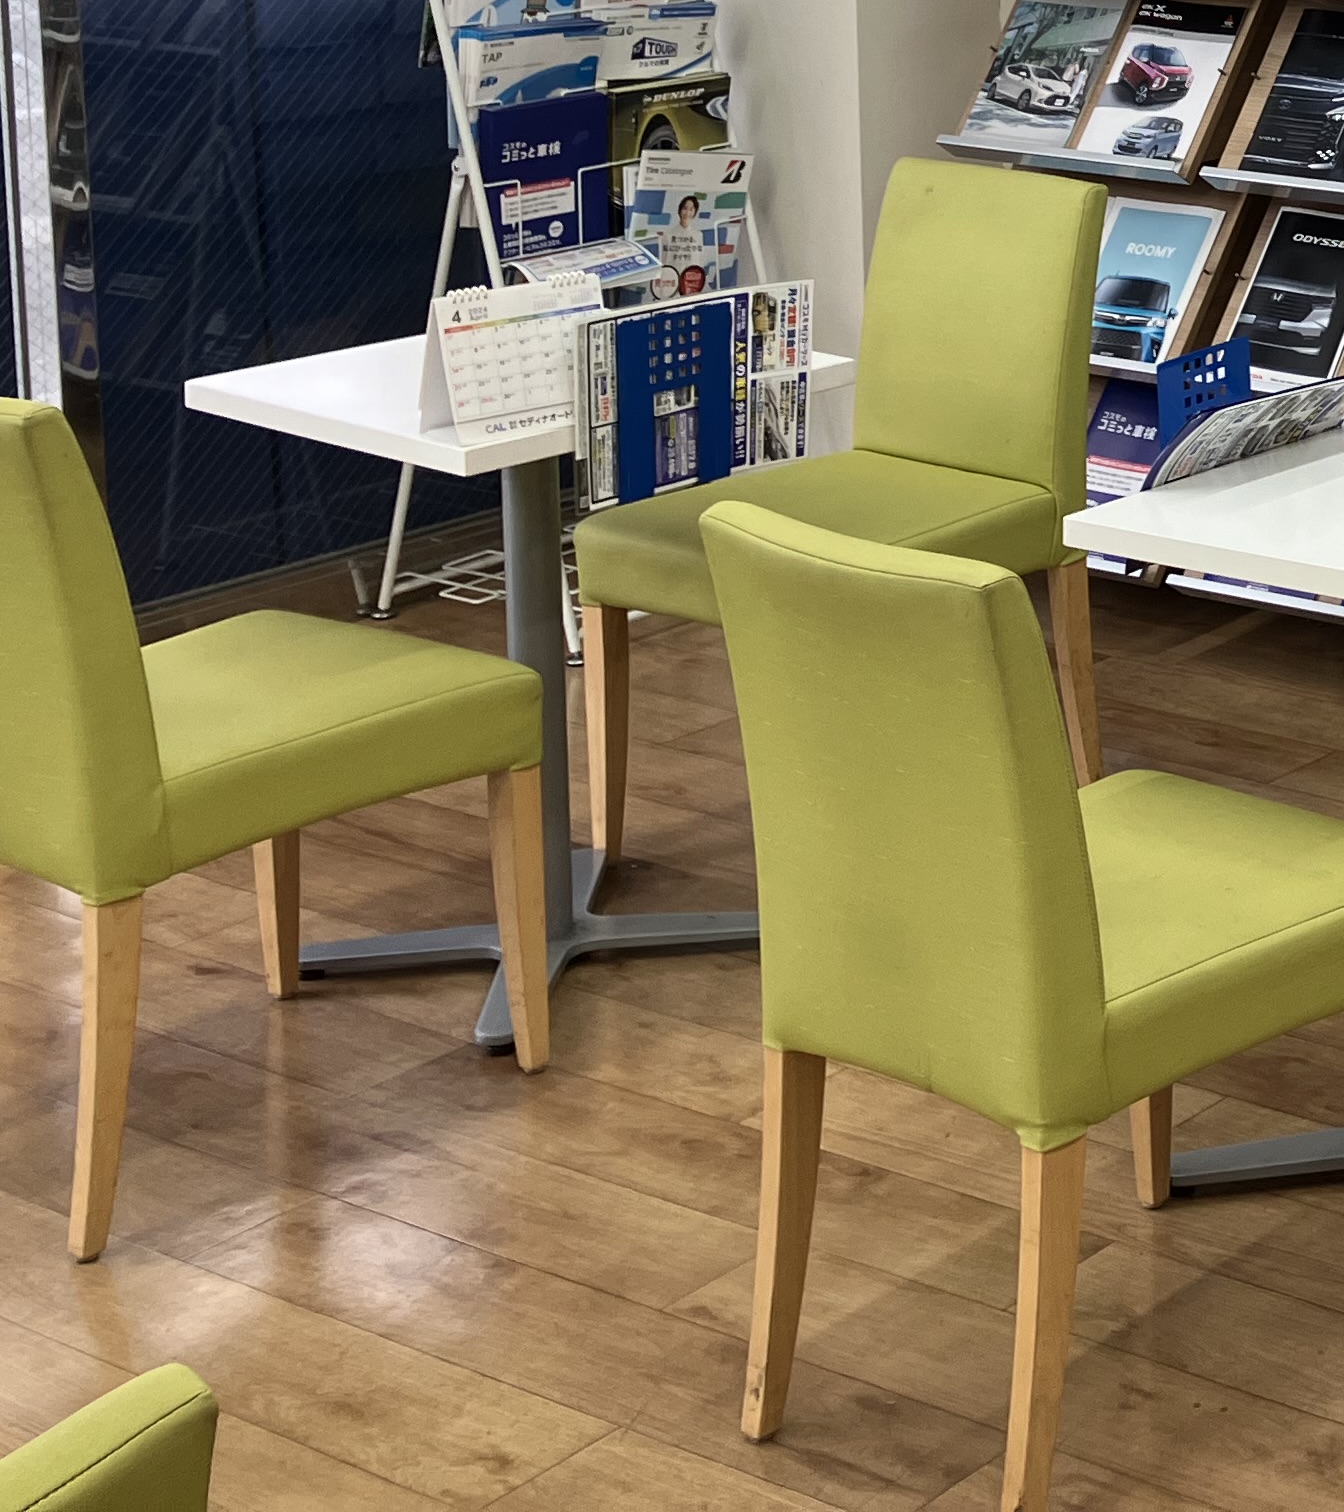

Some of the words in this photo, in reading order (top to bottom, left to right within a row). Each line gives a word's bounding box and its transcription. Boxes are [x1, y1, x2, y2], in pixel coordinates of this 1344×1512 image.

[482, 52, 503, 64] TAP
[651, 88, 705, 104] DUNLOP
[1125, 241, 1176, 260] ROOMY
[452, 310, 461, 323] 4
[1103, 411, 1127, 423] コスモの
[486, 421, 507, 434] CAL
[1097, 419, 1158, 441] コミっと車検
